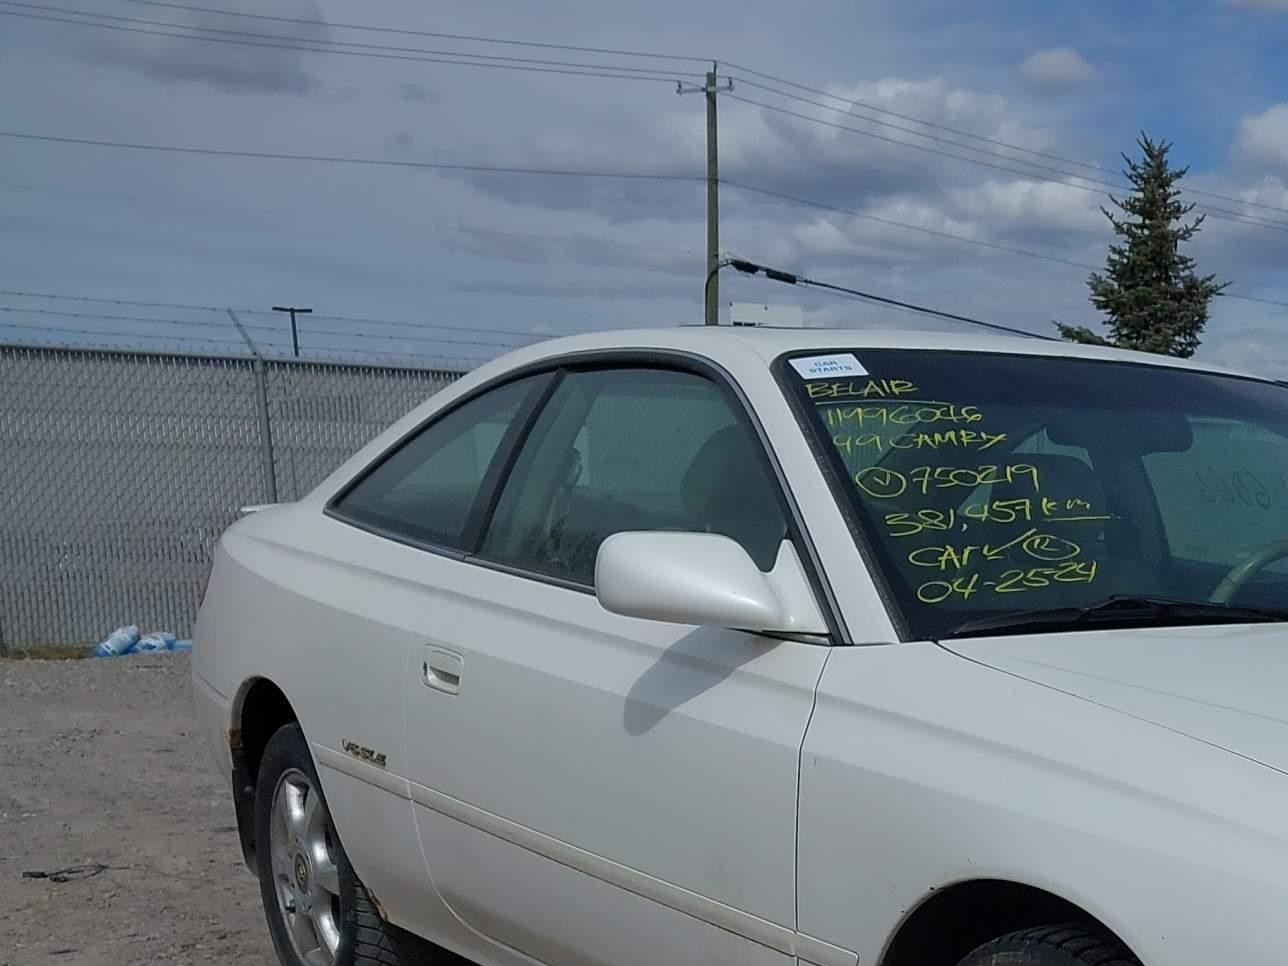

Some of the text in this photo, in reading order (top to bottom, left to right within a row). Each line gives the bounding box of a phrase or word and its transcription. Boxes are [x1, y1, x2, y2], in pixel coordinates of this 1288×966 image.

[808, 365, 853, 374] STARTS
[826, 404, 983, 428] 11996046
[889, 429, 1008, 450] CAMRY
[910, 464, 1040, 493] 750219
[885, 498, 1033, 536] 381,457
[917, 560, 1097, 603] 04-25-24
